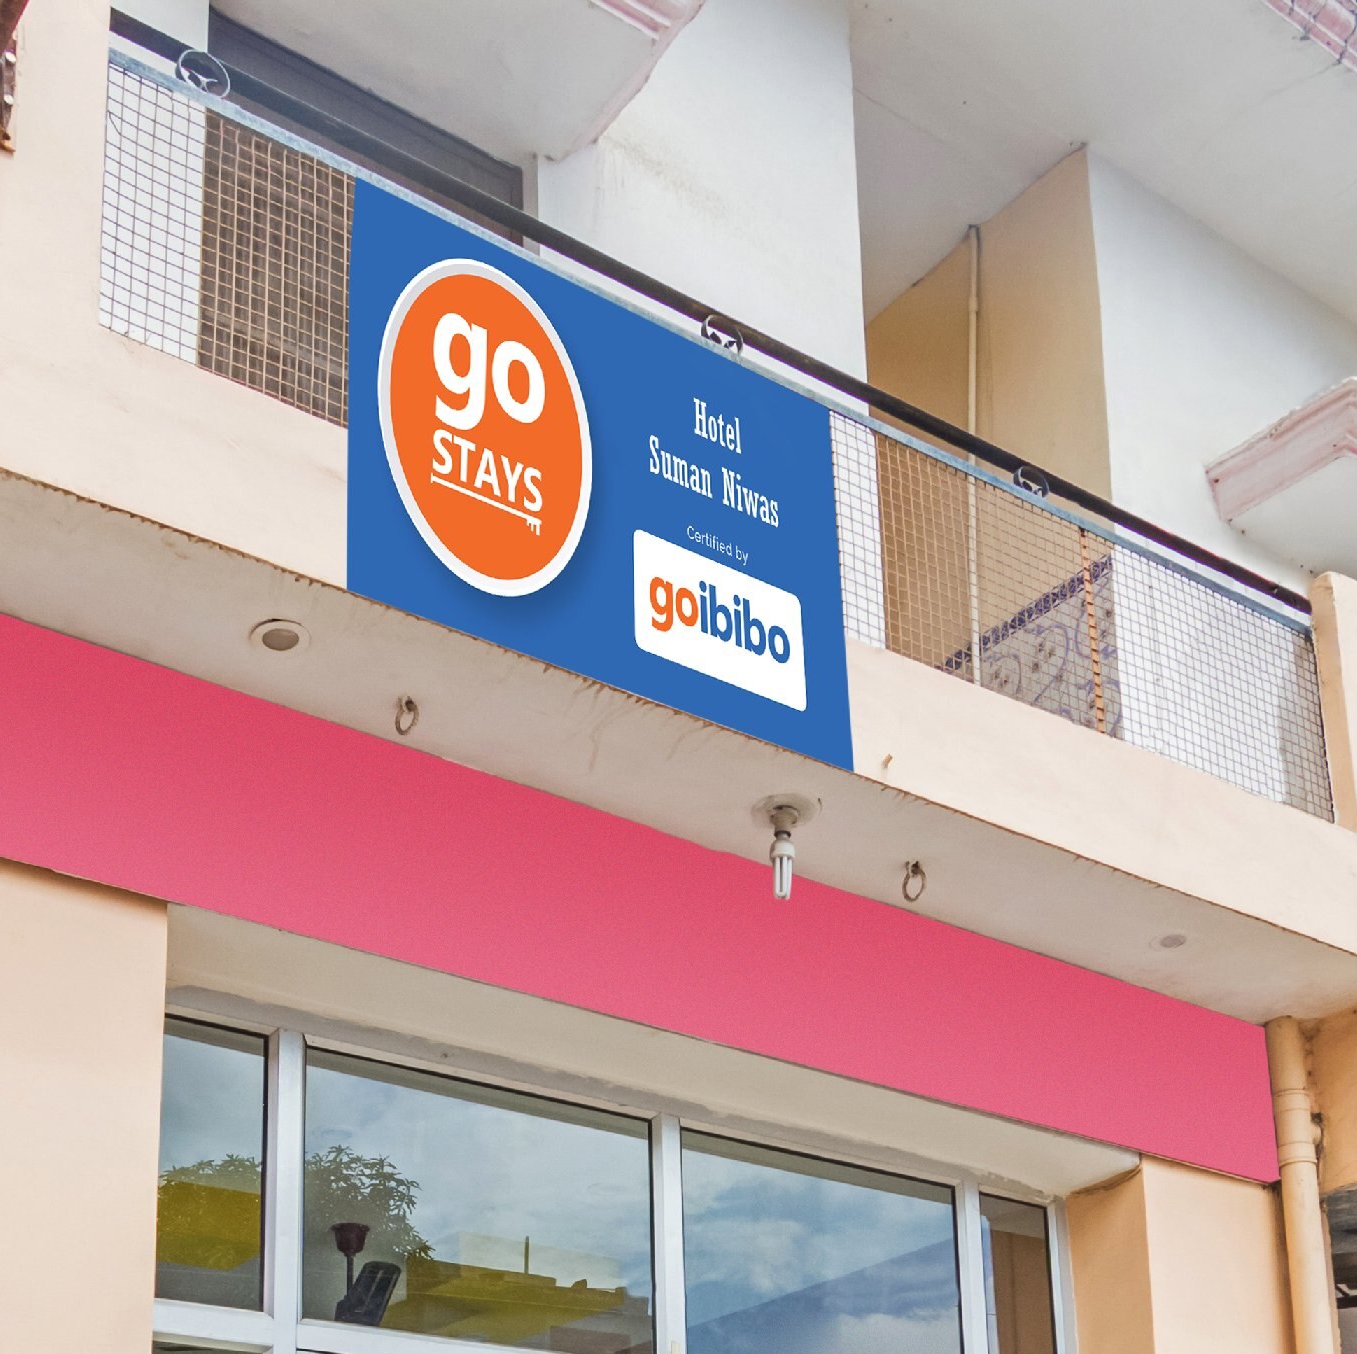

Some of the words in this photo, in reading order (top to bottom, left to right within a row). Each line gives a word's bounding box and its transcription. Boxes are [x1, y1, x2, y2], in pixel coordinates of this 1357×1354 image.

[432, 312, 545, 430] go
[693, 397, 741, 454] Hotel
[431, 429, 543, 513] STAYS
[648, 434, 713, 499] Suman
[721, 466, 779, 528] Niwas
[686, 525, 733, 557] Certified
[735, 545, 749, 566] by
[648, 575, 791, 664] goibibo
